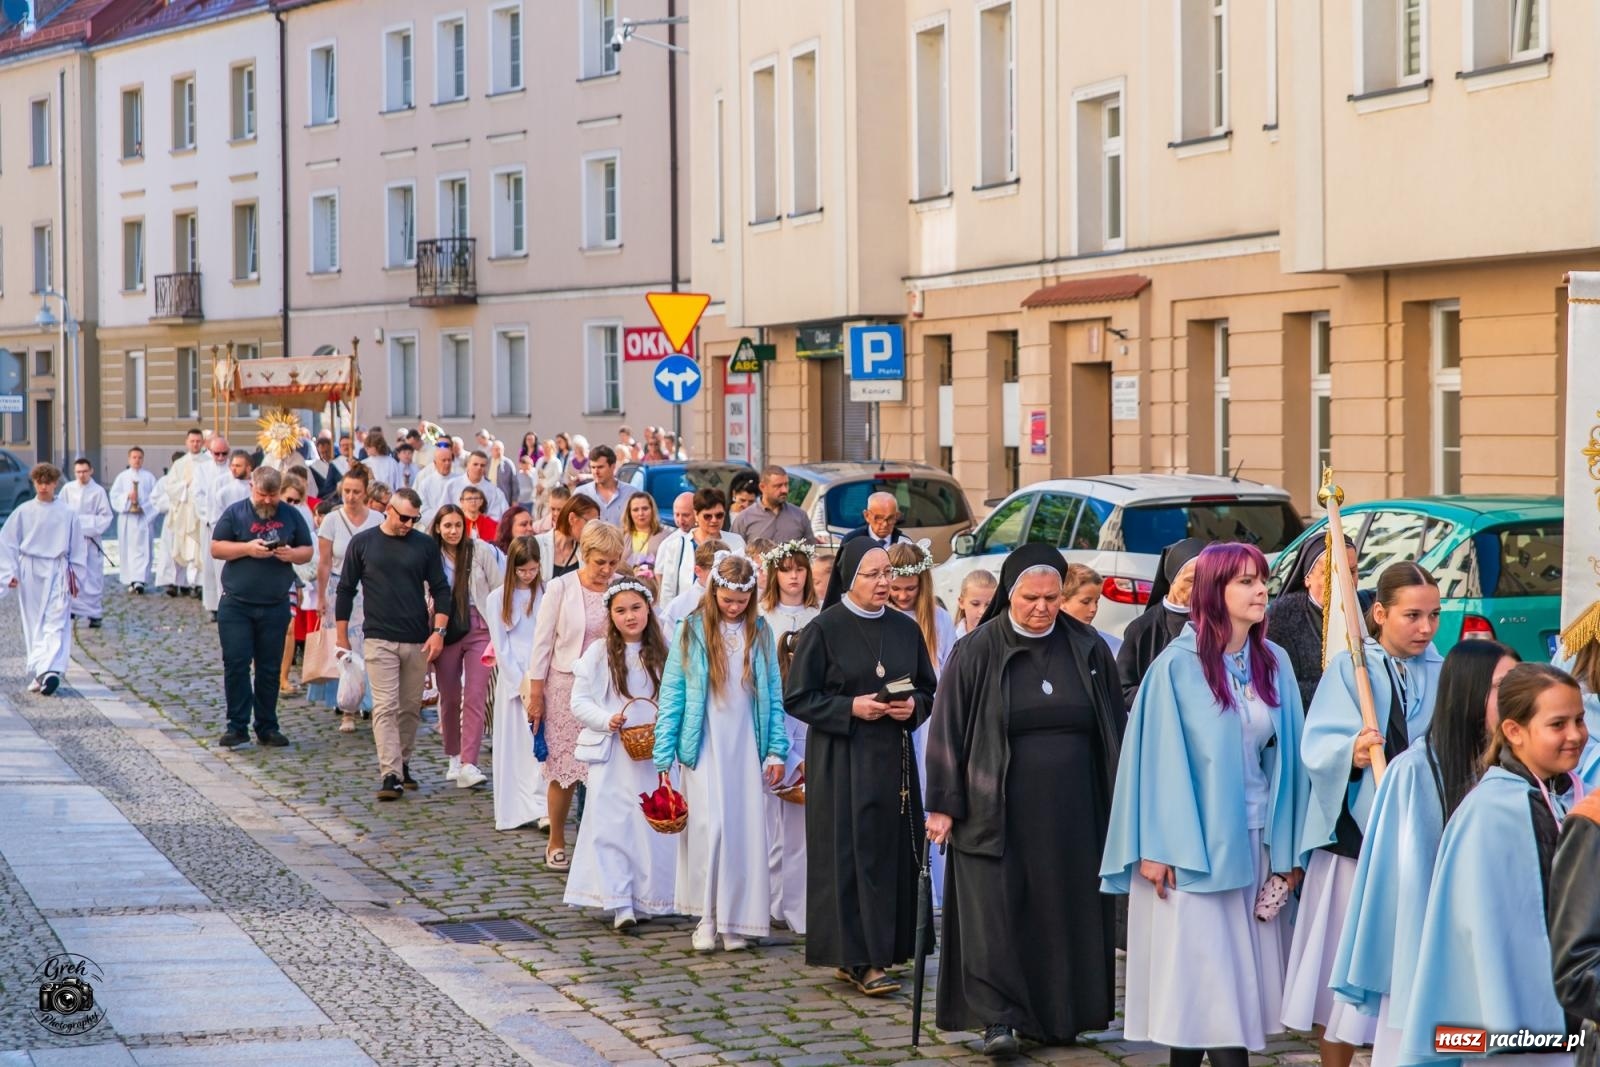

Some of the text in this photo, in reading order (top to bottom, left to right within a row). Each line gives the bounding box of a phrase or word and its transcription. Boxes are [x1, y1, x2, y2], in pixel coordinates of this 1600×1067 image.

[626, 332, 690, 356] OKN
[862, 331, 893, 373] P
[735, 361, 759, 370] ABC
[862, 387, 892, 395] Koniec
